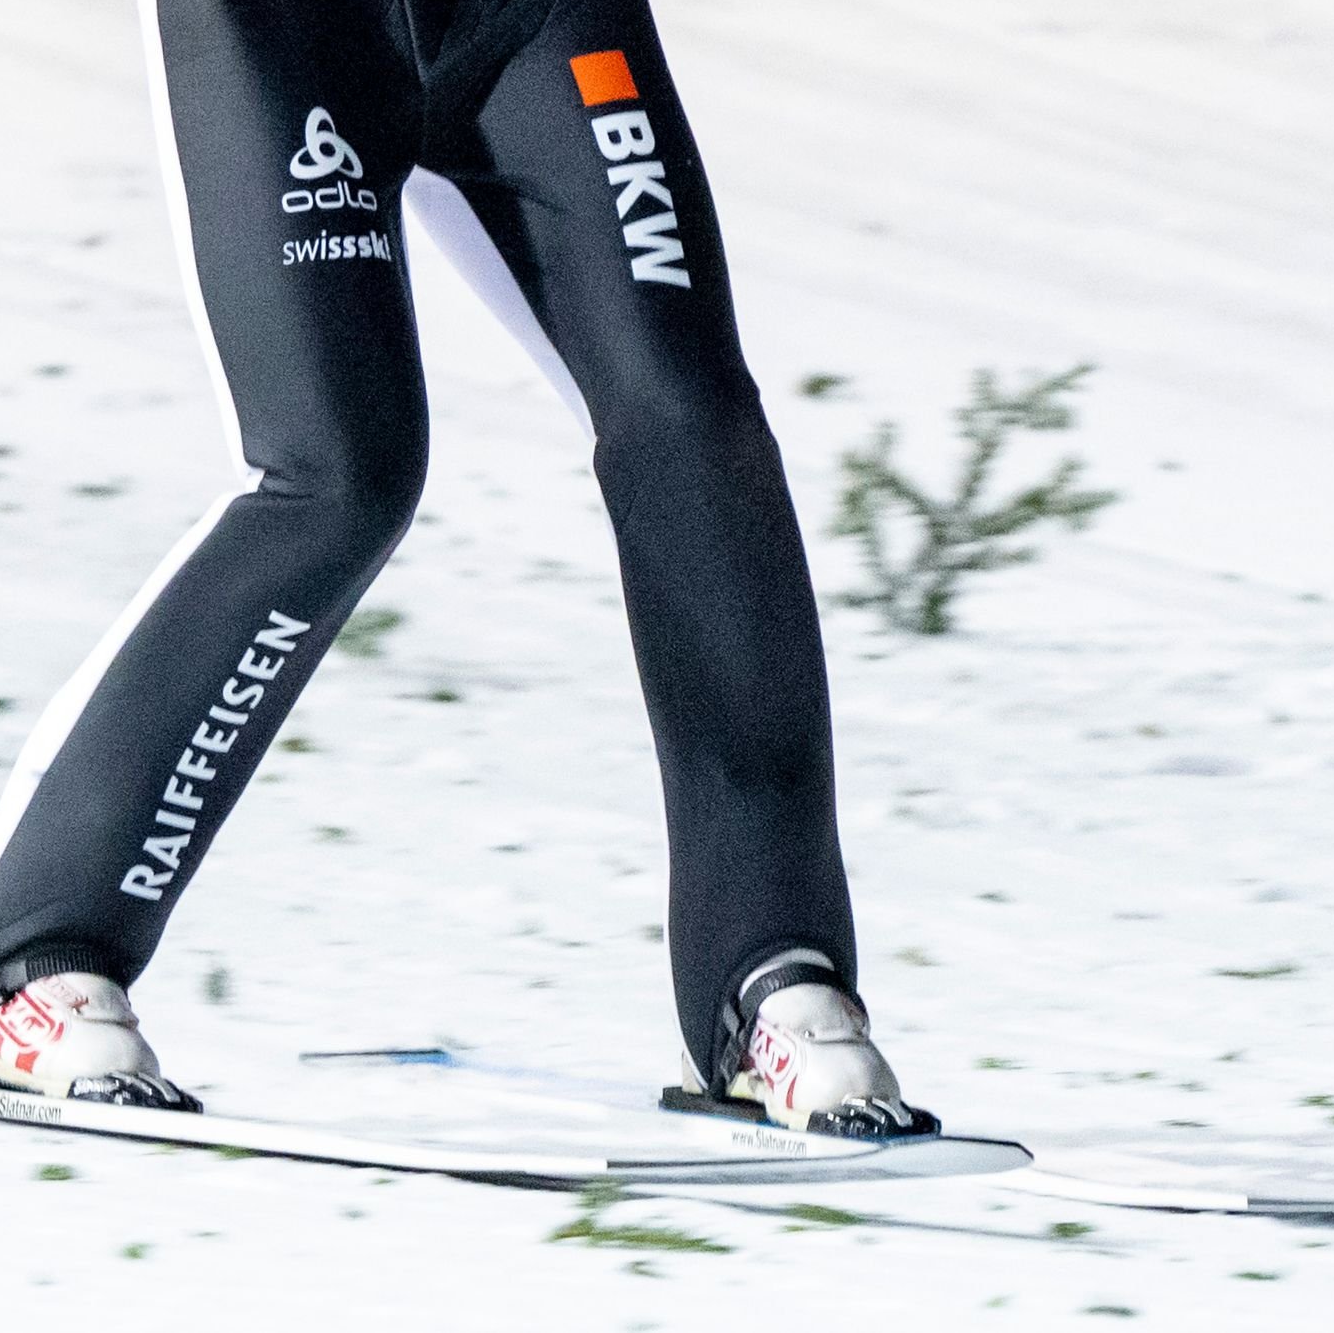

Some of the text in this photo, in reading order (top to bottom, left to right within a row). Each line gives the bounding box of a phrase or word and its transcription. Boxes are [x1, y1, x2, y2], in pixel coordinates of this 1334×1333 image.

[281, 180, 378, 213] odlo
[283, 229, 392, 265] swissski
[591, 109, 692, 289] BKW
[120, 609, 311, 901] RAIFFEISEN
